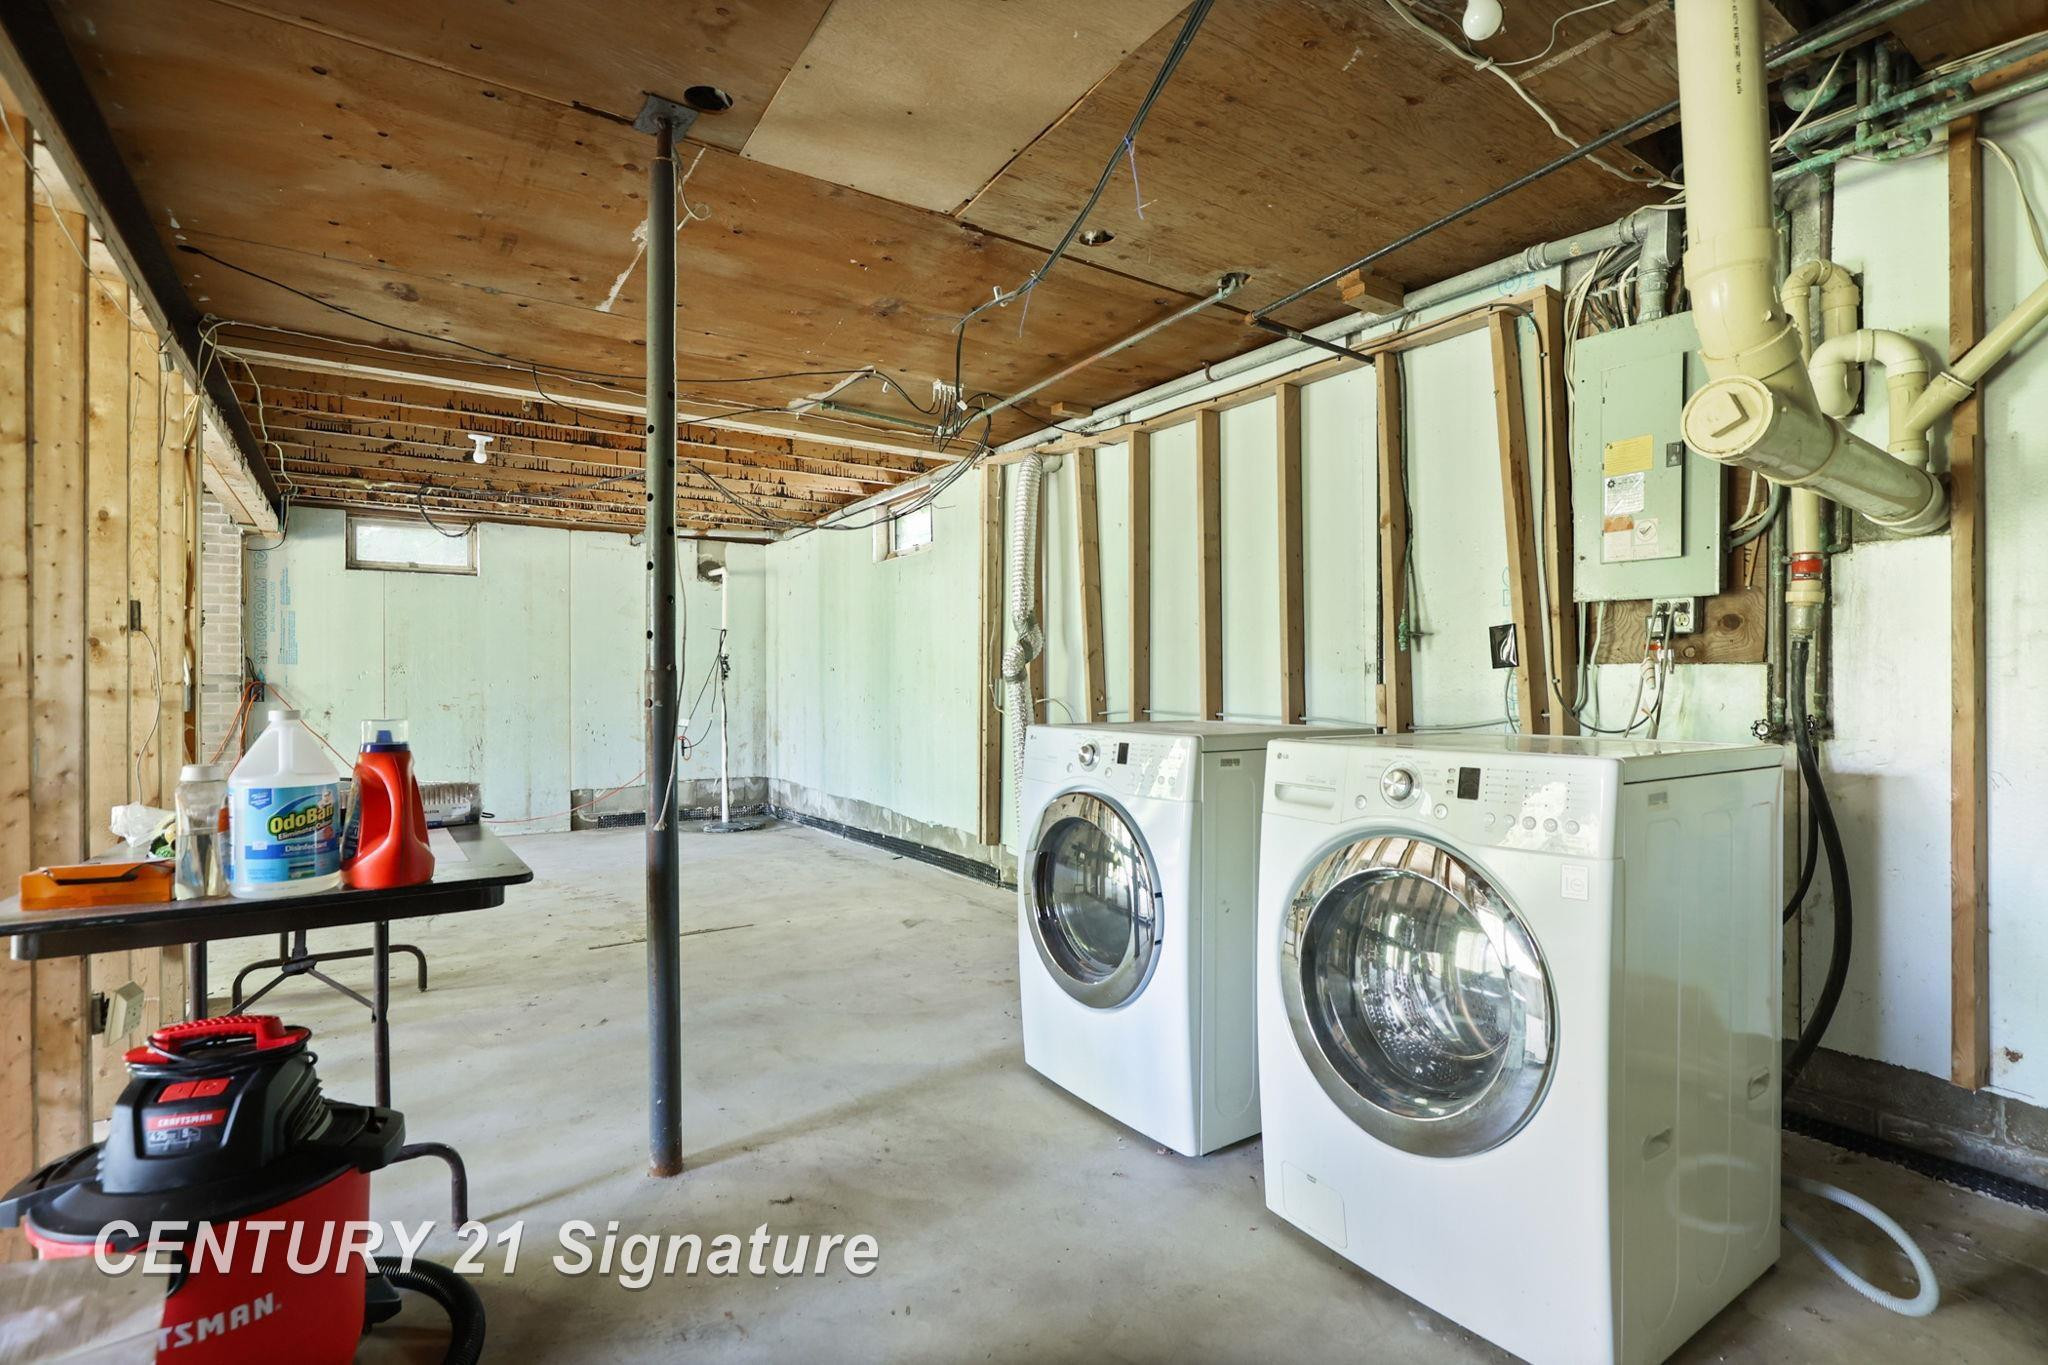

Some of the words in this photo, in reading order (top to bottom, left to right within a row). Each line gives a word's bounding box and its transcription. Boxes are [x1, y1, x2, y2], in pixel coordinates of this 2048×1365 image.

[253, 576, 267, 665] STYROFOAM
[270, 806, 333, 834] OdoBan
[285, 842, 327, 852] Disinfectant
[158, 1113, 213, 1127] CRAFTSMAN
[156, 1291, 274, 1352] TSMAN
